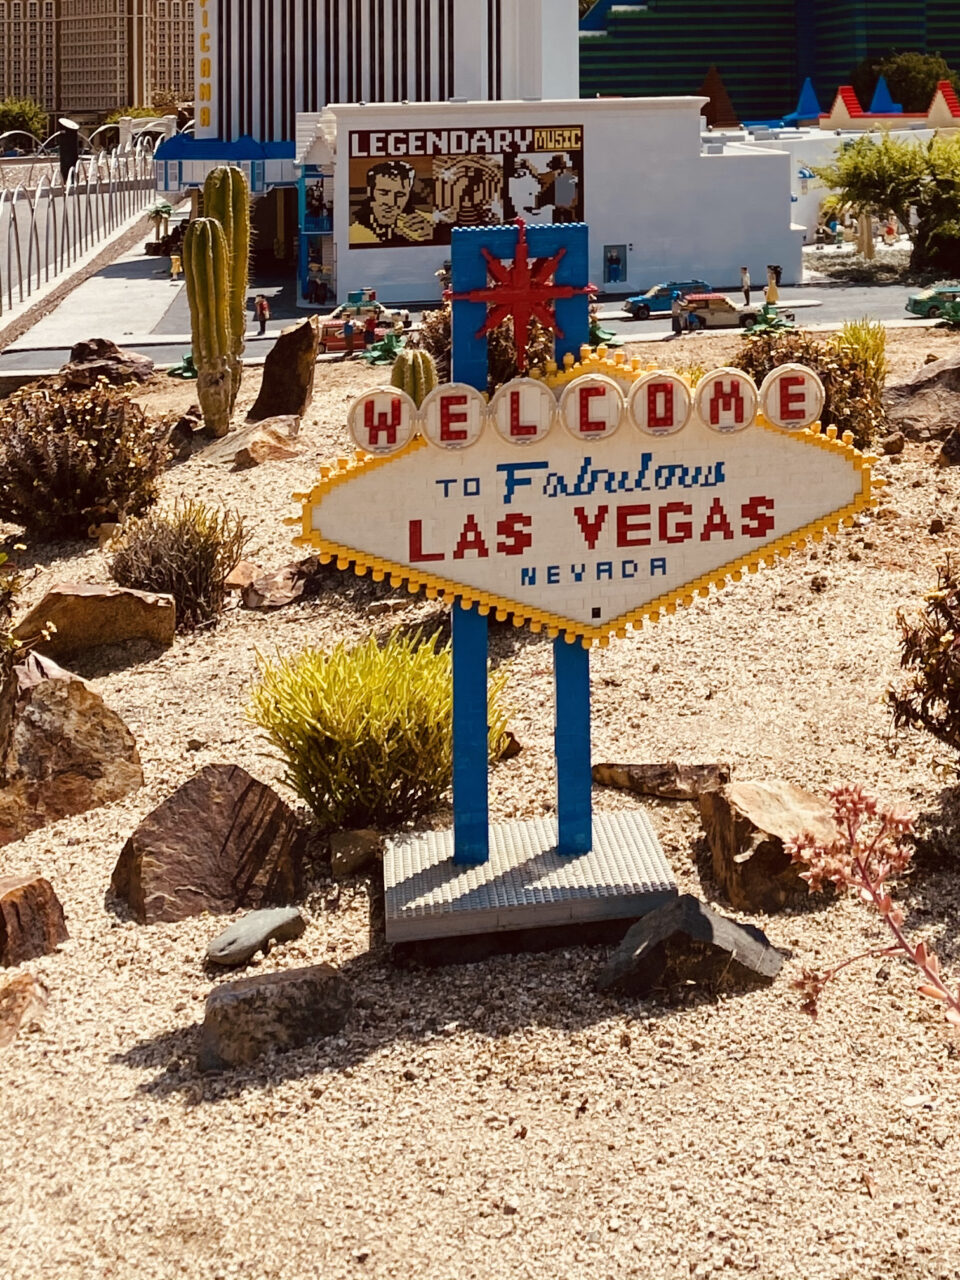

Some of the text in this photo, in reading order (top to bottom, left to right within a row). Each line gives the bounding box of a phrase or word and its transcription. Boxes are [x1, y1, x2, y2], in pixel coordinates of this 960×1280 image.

[351, 128, 582, 157] LEGENDARY MUSIC
[363, 375, 807, 446] WELCOME
[435, 452, 726, 504] TO Fabulous
[408, 495, 776, 563] LAS VEGAS
[521, 556, 668, 587] NEVADA
